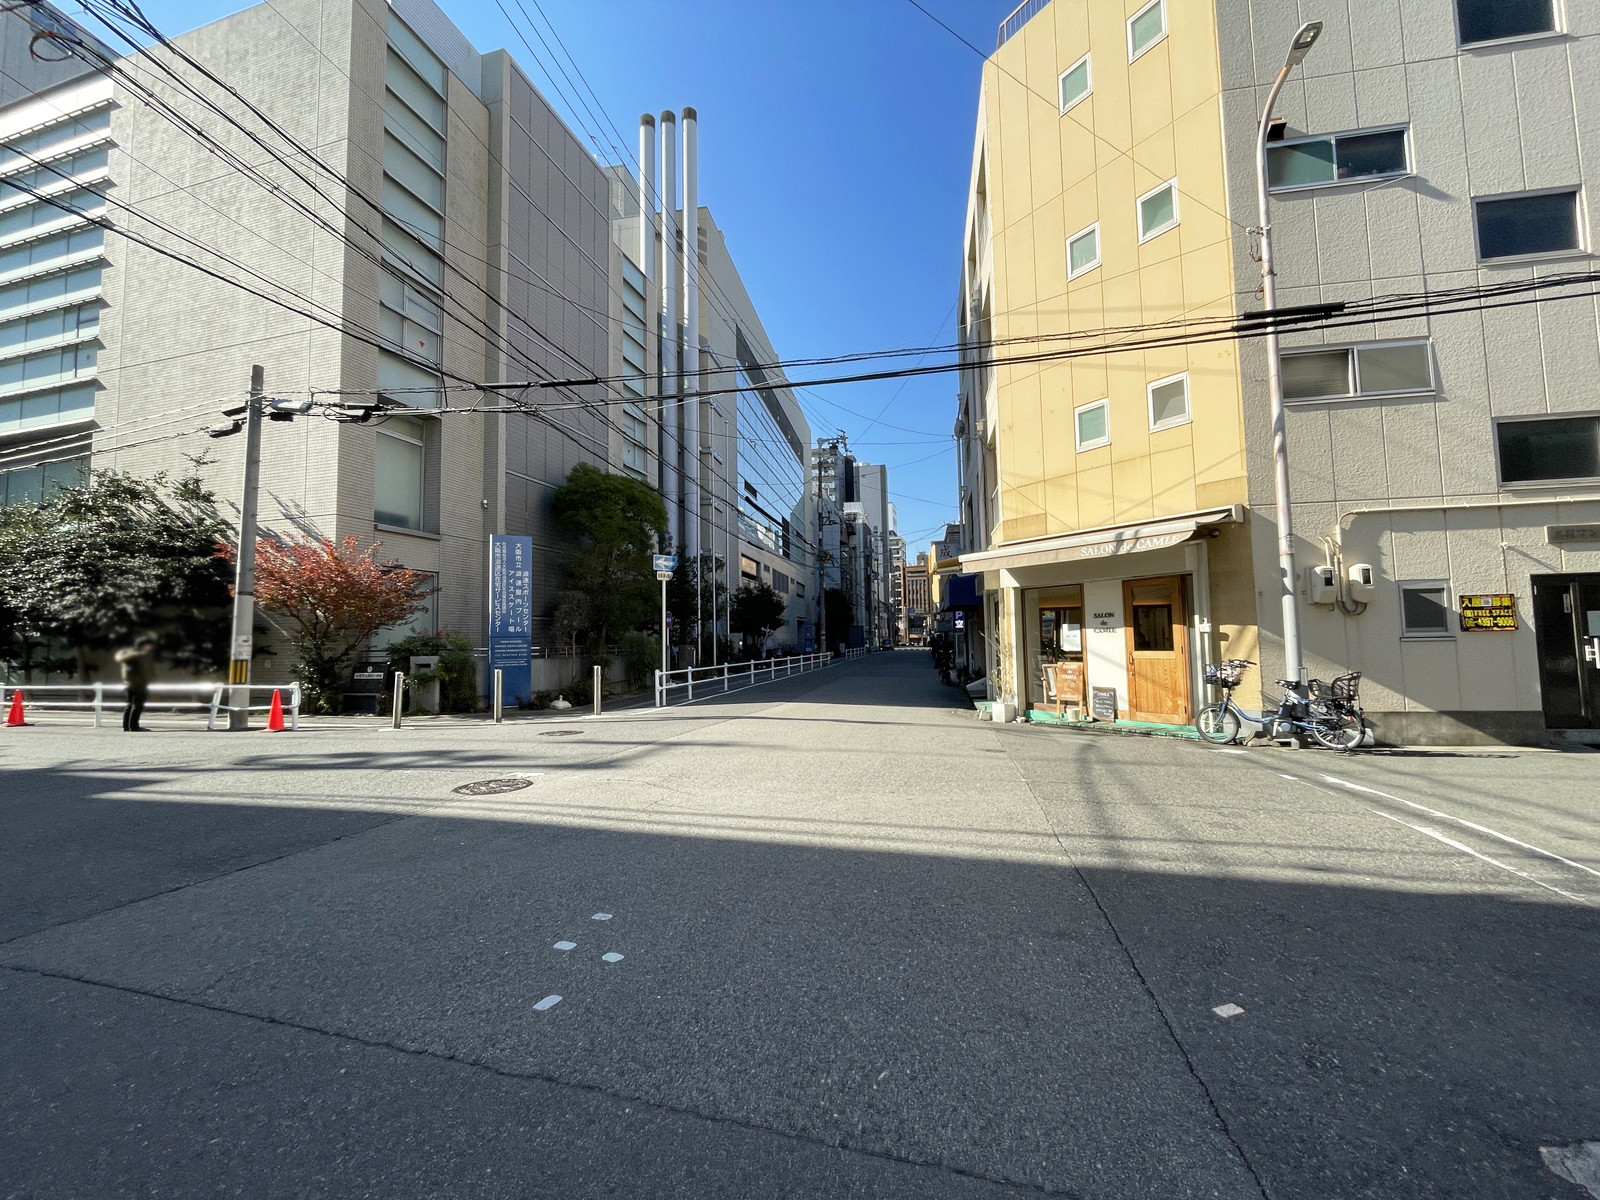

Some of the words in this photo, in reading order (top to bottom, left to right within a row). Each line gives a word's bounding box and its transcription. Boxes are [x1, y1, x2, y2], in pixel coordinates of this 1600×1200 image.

[1080, 543, 1116, 557] SALON
[1120, 541, 1133, 552] de
[955, 611, 963, 619] P
